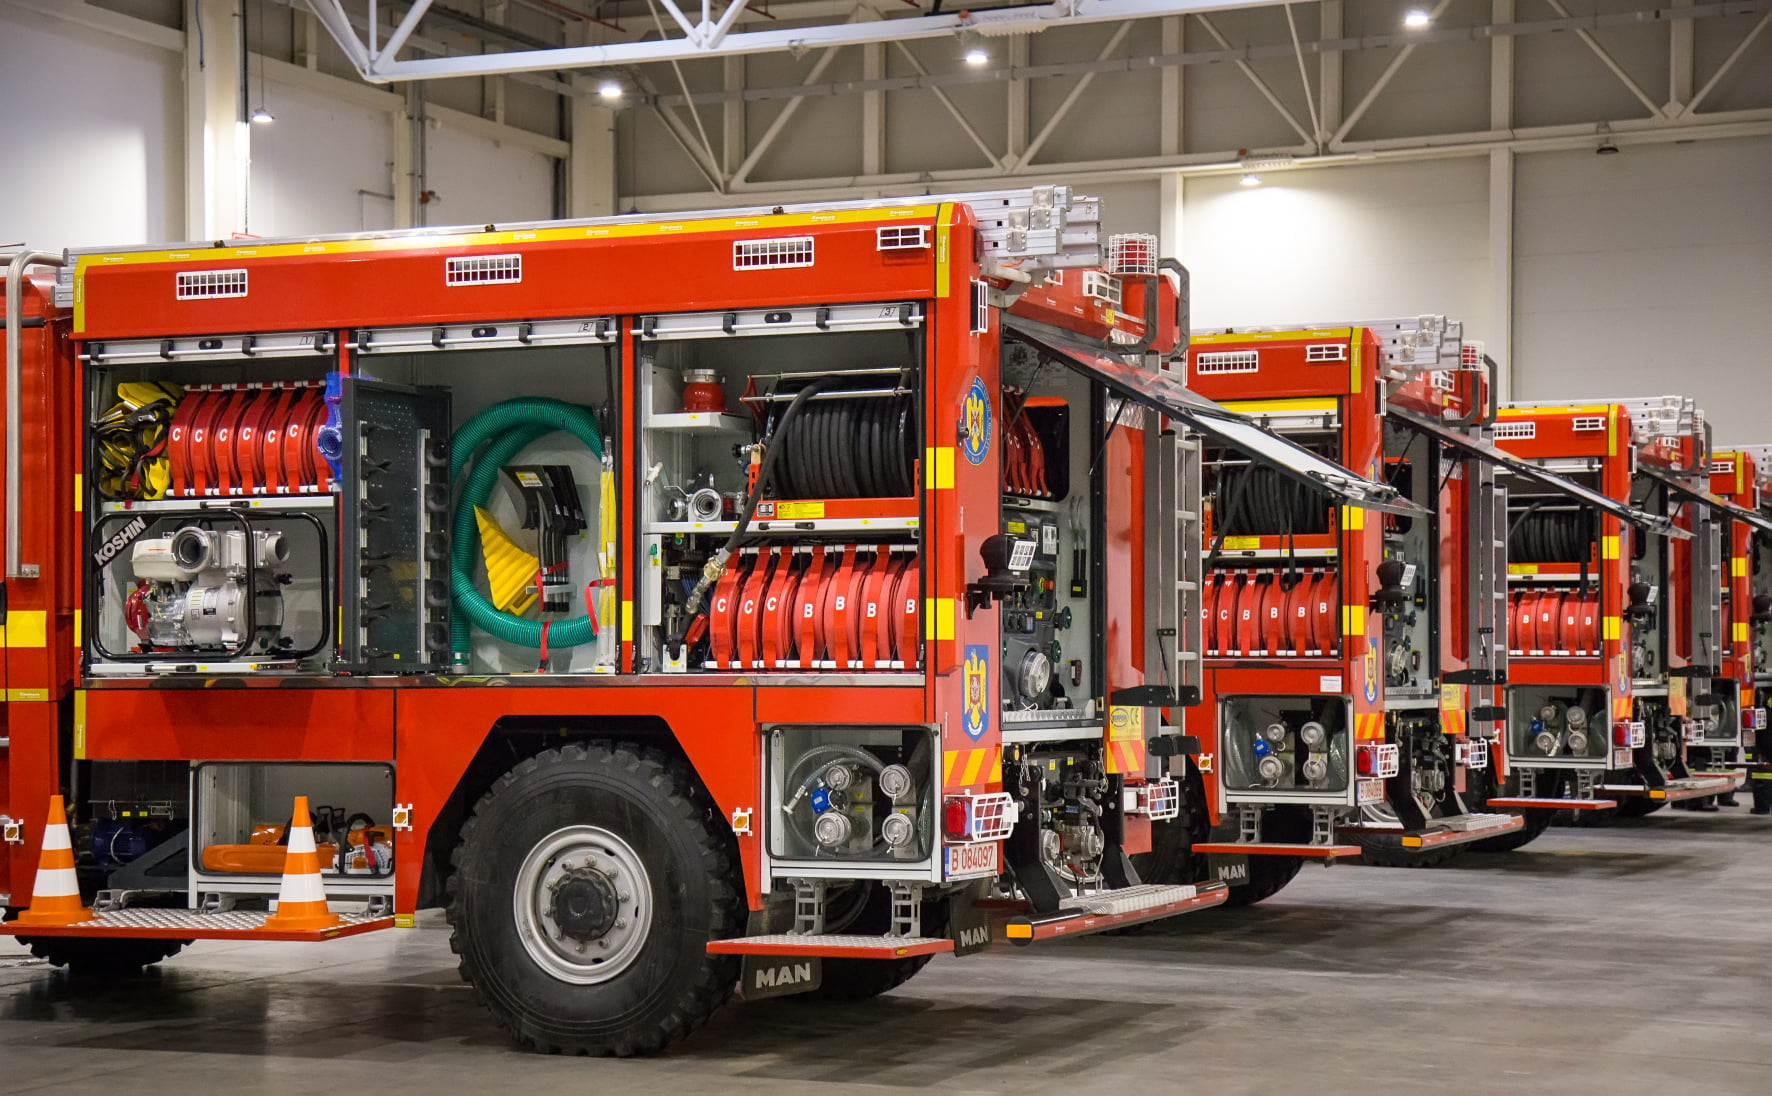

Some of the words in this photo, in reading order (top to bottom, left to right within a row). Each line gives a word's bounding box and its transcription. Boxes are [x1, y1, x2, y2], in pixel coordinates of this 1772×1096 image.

[172, 428, 181, 442] C
[195, 429, 203, 443] C
[219, 428, 228, 442] C
[242, 427, 251, 441] C
[267, 429, 276, 443] C
[289, 424, 298, 438] C
[94, 516, 147, 566] KOSHIN
[717, 598, 726, 612] C
[744, 600, 754, 614] C
[767, 597, 777, 611] C
[835, 596, 845, 610] B
[866, 602, 876, 617] B
[905, 599, 916, 613] B
[1319, 602, 1327, 613] B
[803, 603, 813, 618] B
[1220, 610, 1228, 620] C
[1242, 609, 1250, 620] B
[1270, 607, 1278, 618] B
[1298, 606, 1306, 617] B
[951, 849, 959, 871] B
[961, 845, 994, 870] 084097
[1217, 863, 1246, 881] MAN
[960, 925, 989, 948] MAN
[755, 962, 811, 989] MAN
